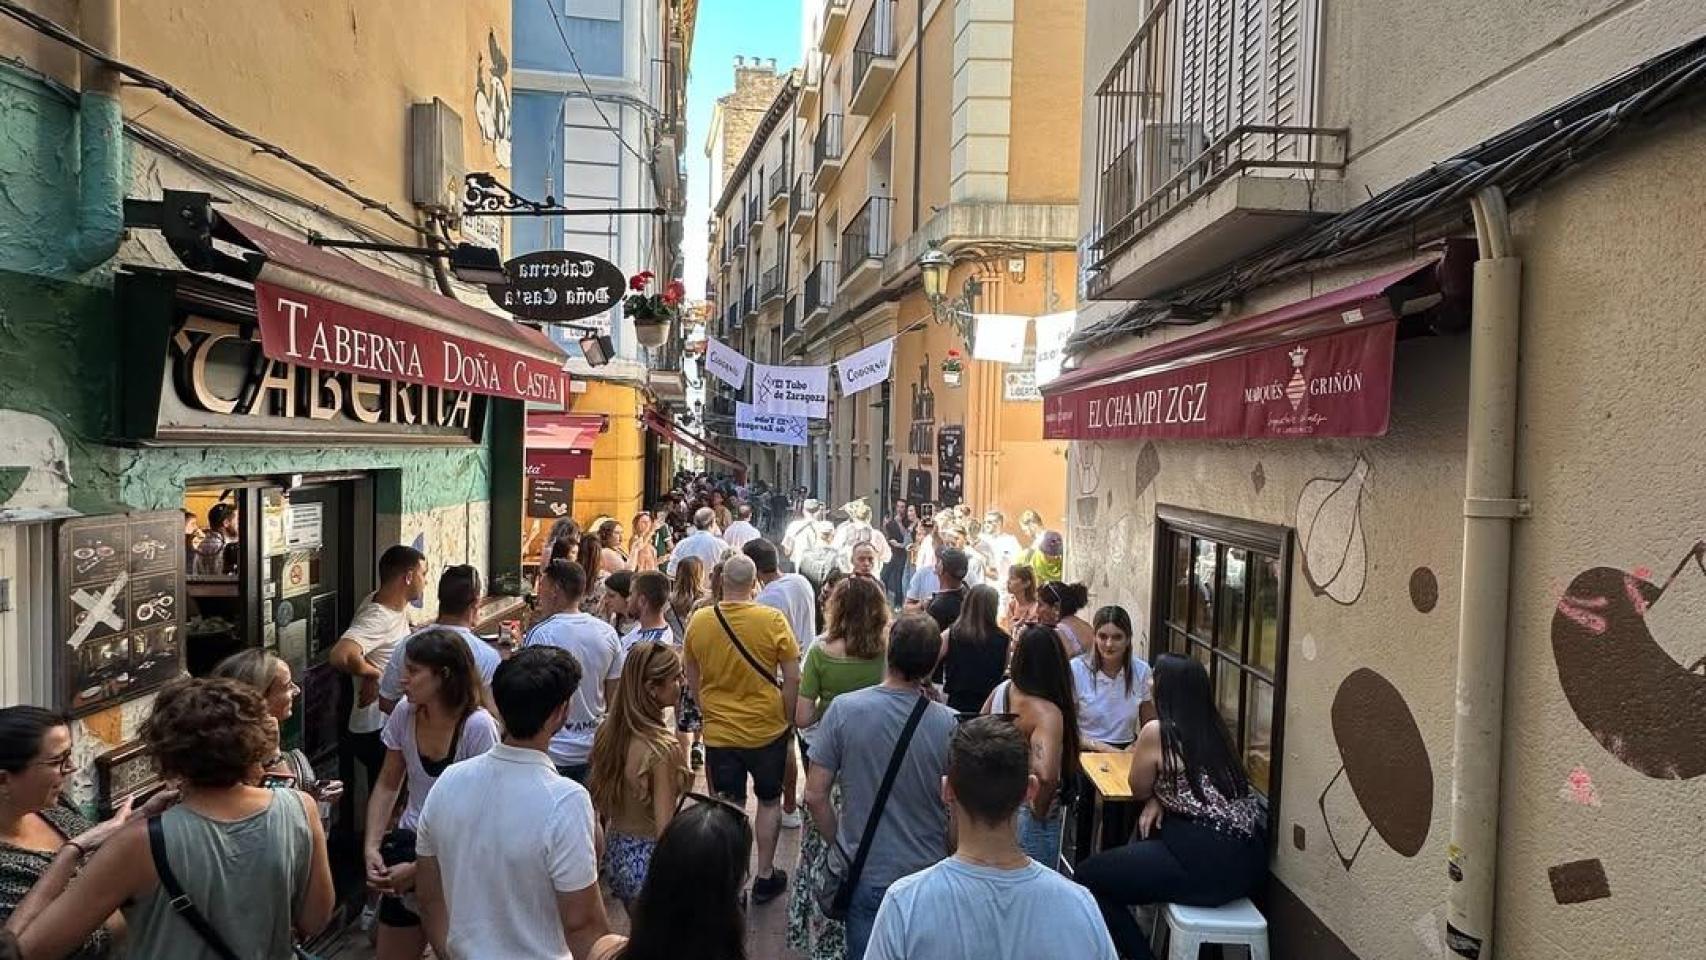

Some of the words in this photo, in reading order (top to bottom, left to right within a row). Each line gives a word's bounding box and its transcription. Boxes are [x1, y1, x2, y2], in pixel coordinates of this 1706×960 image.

[277, 297, 424, 379] TABERNA
[443, 340, 501, 391] DOÑA
[513, 360, 557, 399] CASTA
[785, 379, 807, 390] Tubo
[1310, 368, 1364, 396] GRIÑÓN
[774, 390, 783, 399] de
[786, 391, 825, 403] Zaragoza
[1088, 399, 1102, 428] EL
[1105, 389, 1162, 427] CHAMPI
[1166, 381, 1208, 424] ZGZ
